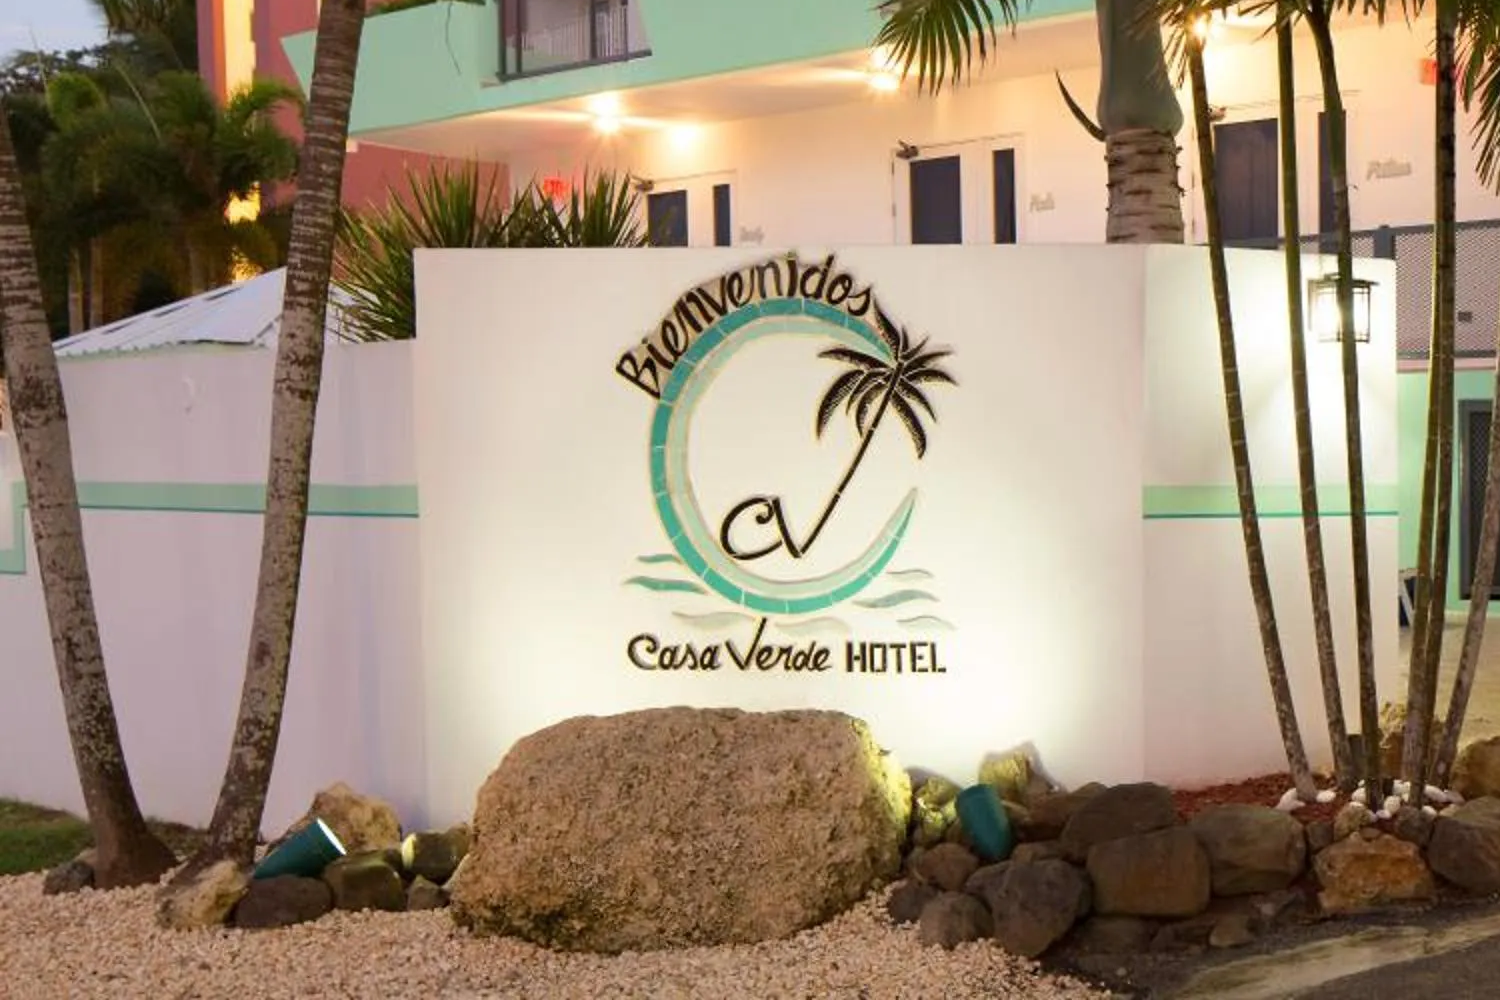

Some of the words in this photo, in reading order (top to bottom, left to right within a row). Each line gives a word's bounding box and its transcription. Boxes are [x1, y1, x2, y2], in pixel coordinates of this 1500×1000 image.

[615, 252, 873, 399] Bienvenidos
[627, 633, 719, 671] Casa
[725, 617, 832, 671] Verde
[845, 642, 946, 673] HOTEL
